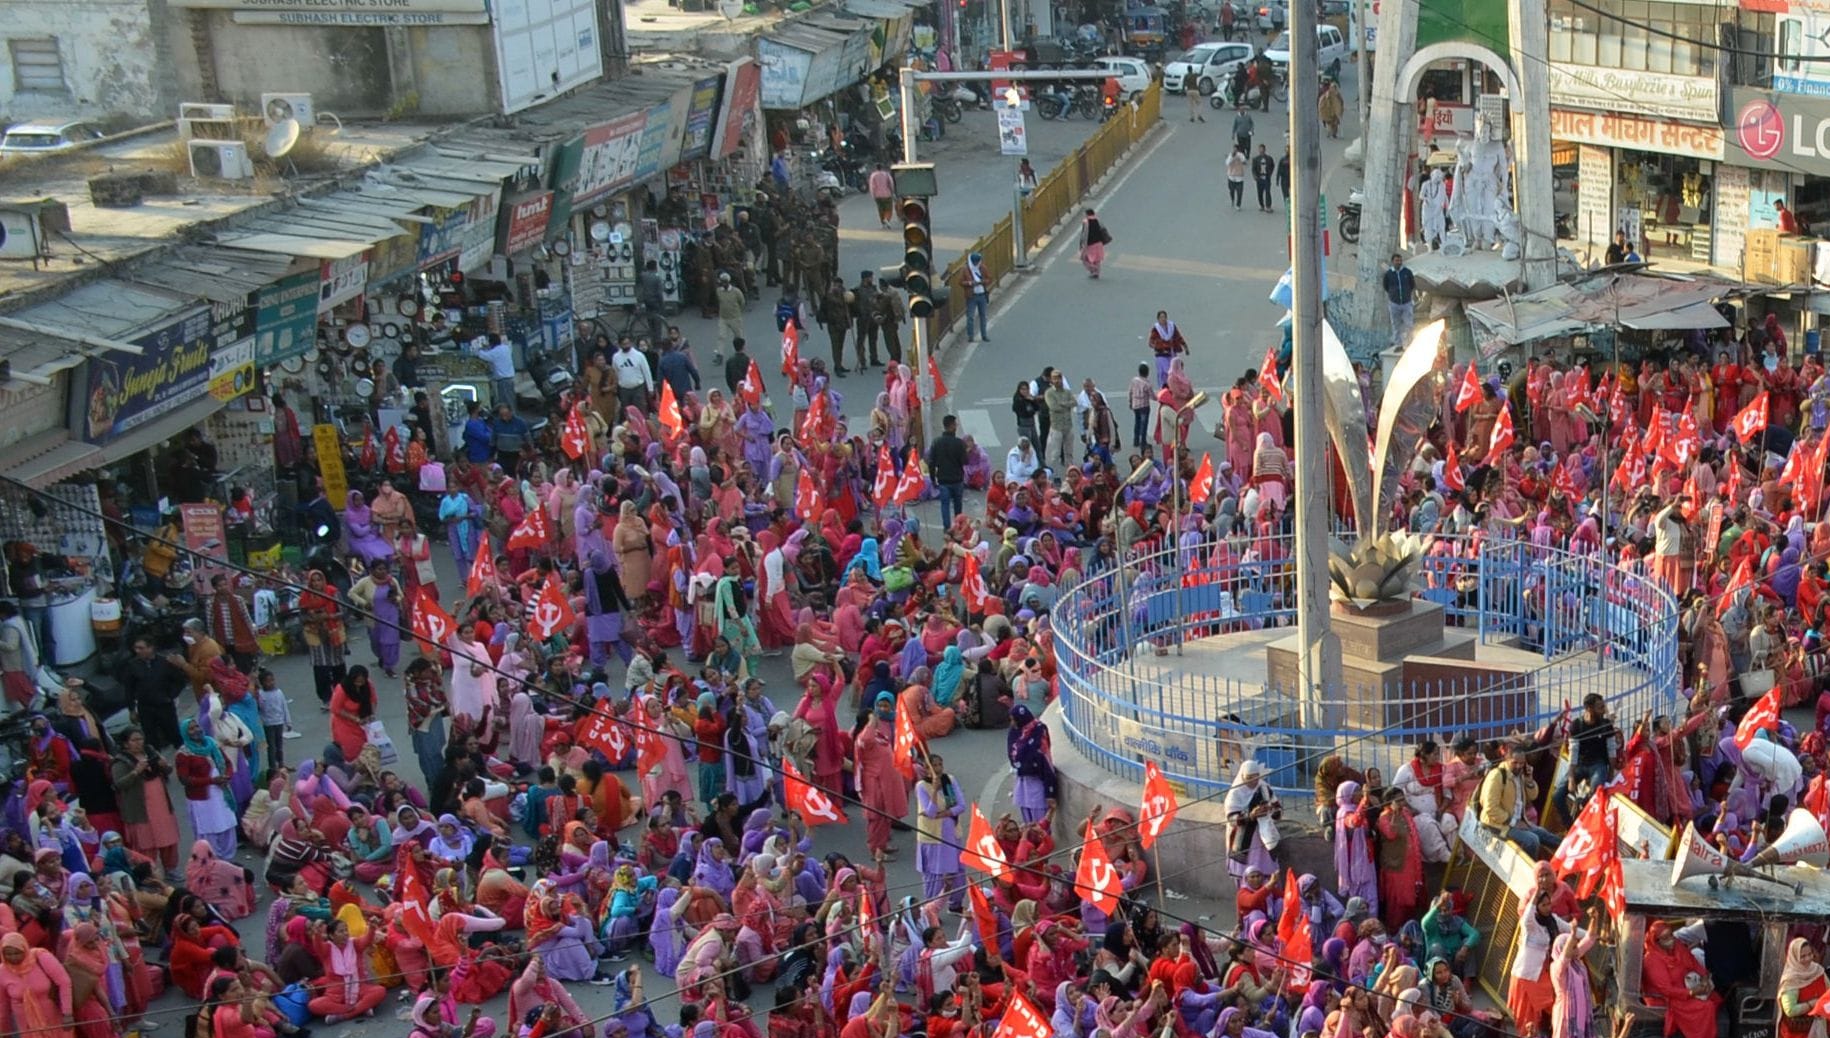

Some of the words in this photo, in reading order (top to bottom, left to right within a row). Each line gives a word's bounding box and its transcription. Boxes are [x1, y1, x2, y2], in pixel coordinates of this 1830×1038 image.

[279, 14, 338, 23] SUBHASH
[341, 14, 400, 23] ELECTRIC
[403, 14, 443, 23] STORE
